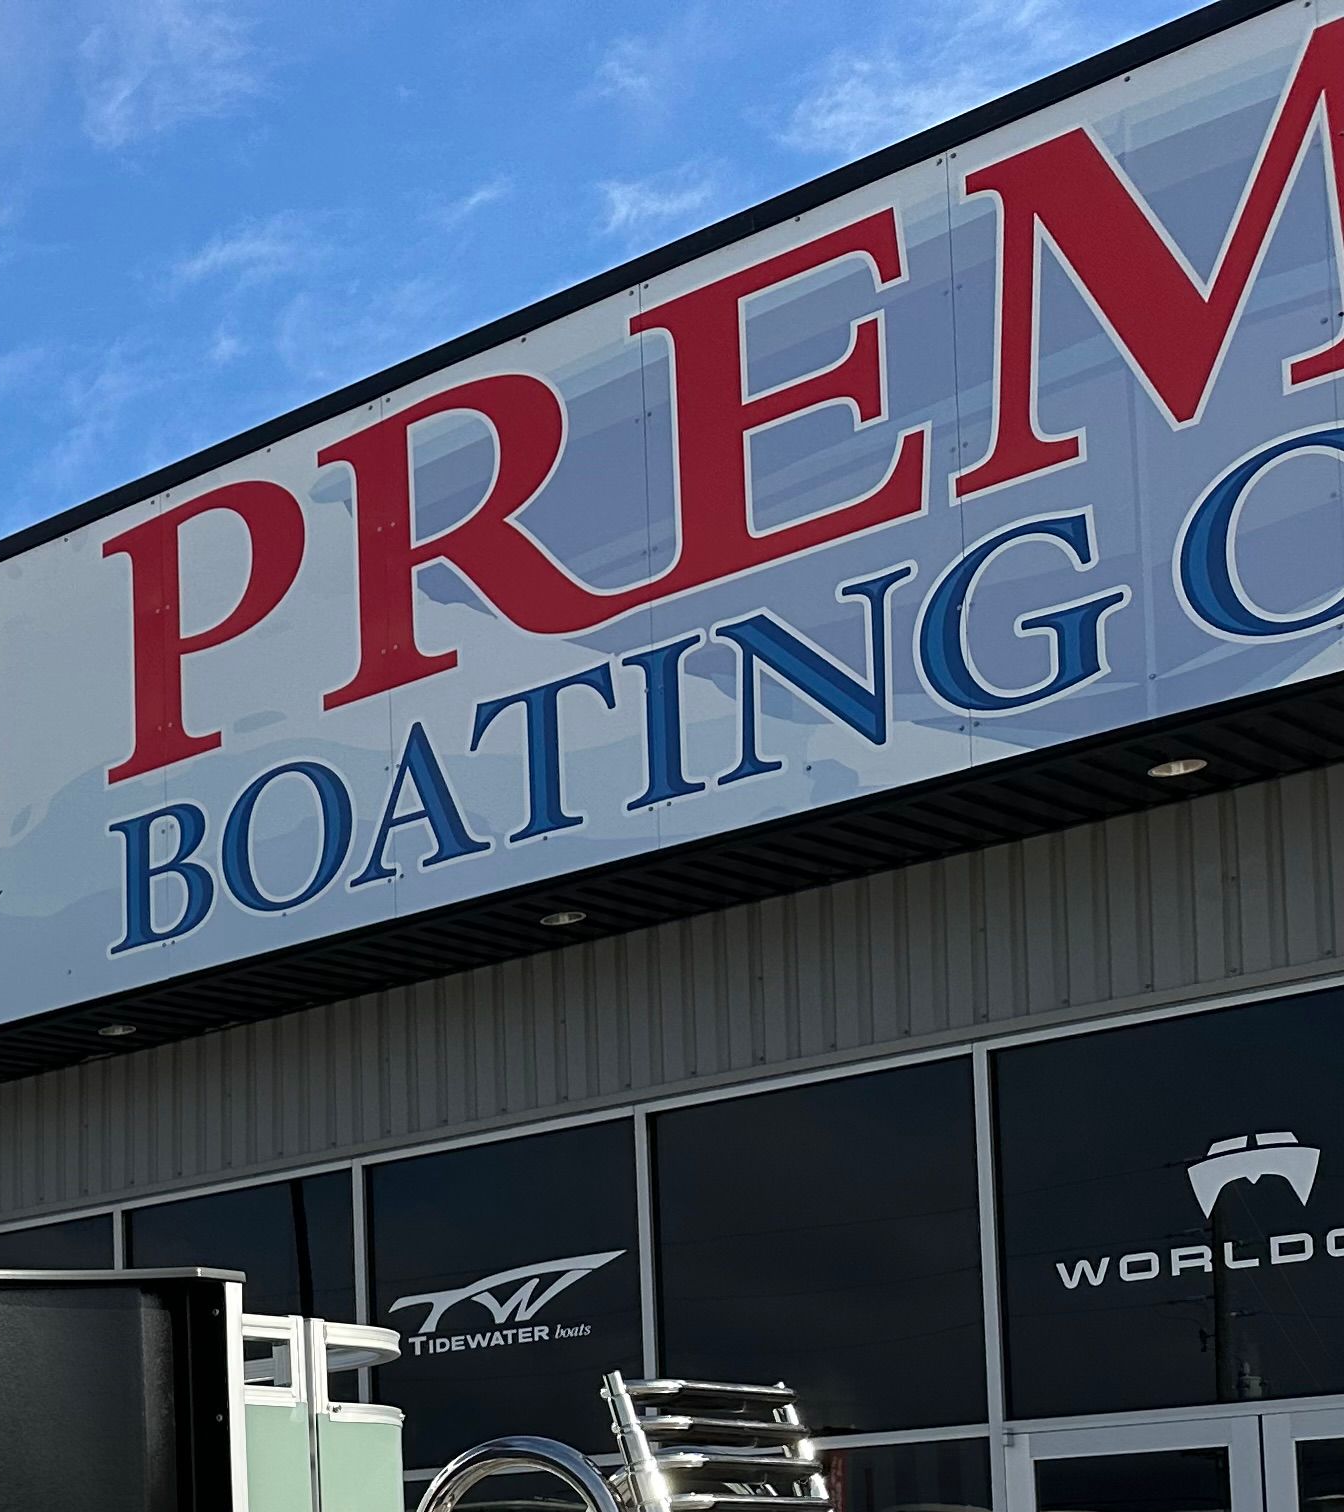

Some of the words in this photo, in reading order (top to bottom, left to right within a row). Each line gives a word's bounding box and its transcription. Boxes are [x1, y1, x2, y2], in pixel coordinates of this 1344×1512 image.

[102, 15, 1344, 785] PREM
[110, 512, 1125, 953] BOATING
[408, 1325, 550, 1356] TIDEWATER
[554, 1323, 592, 1340] boats
